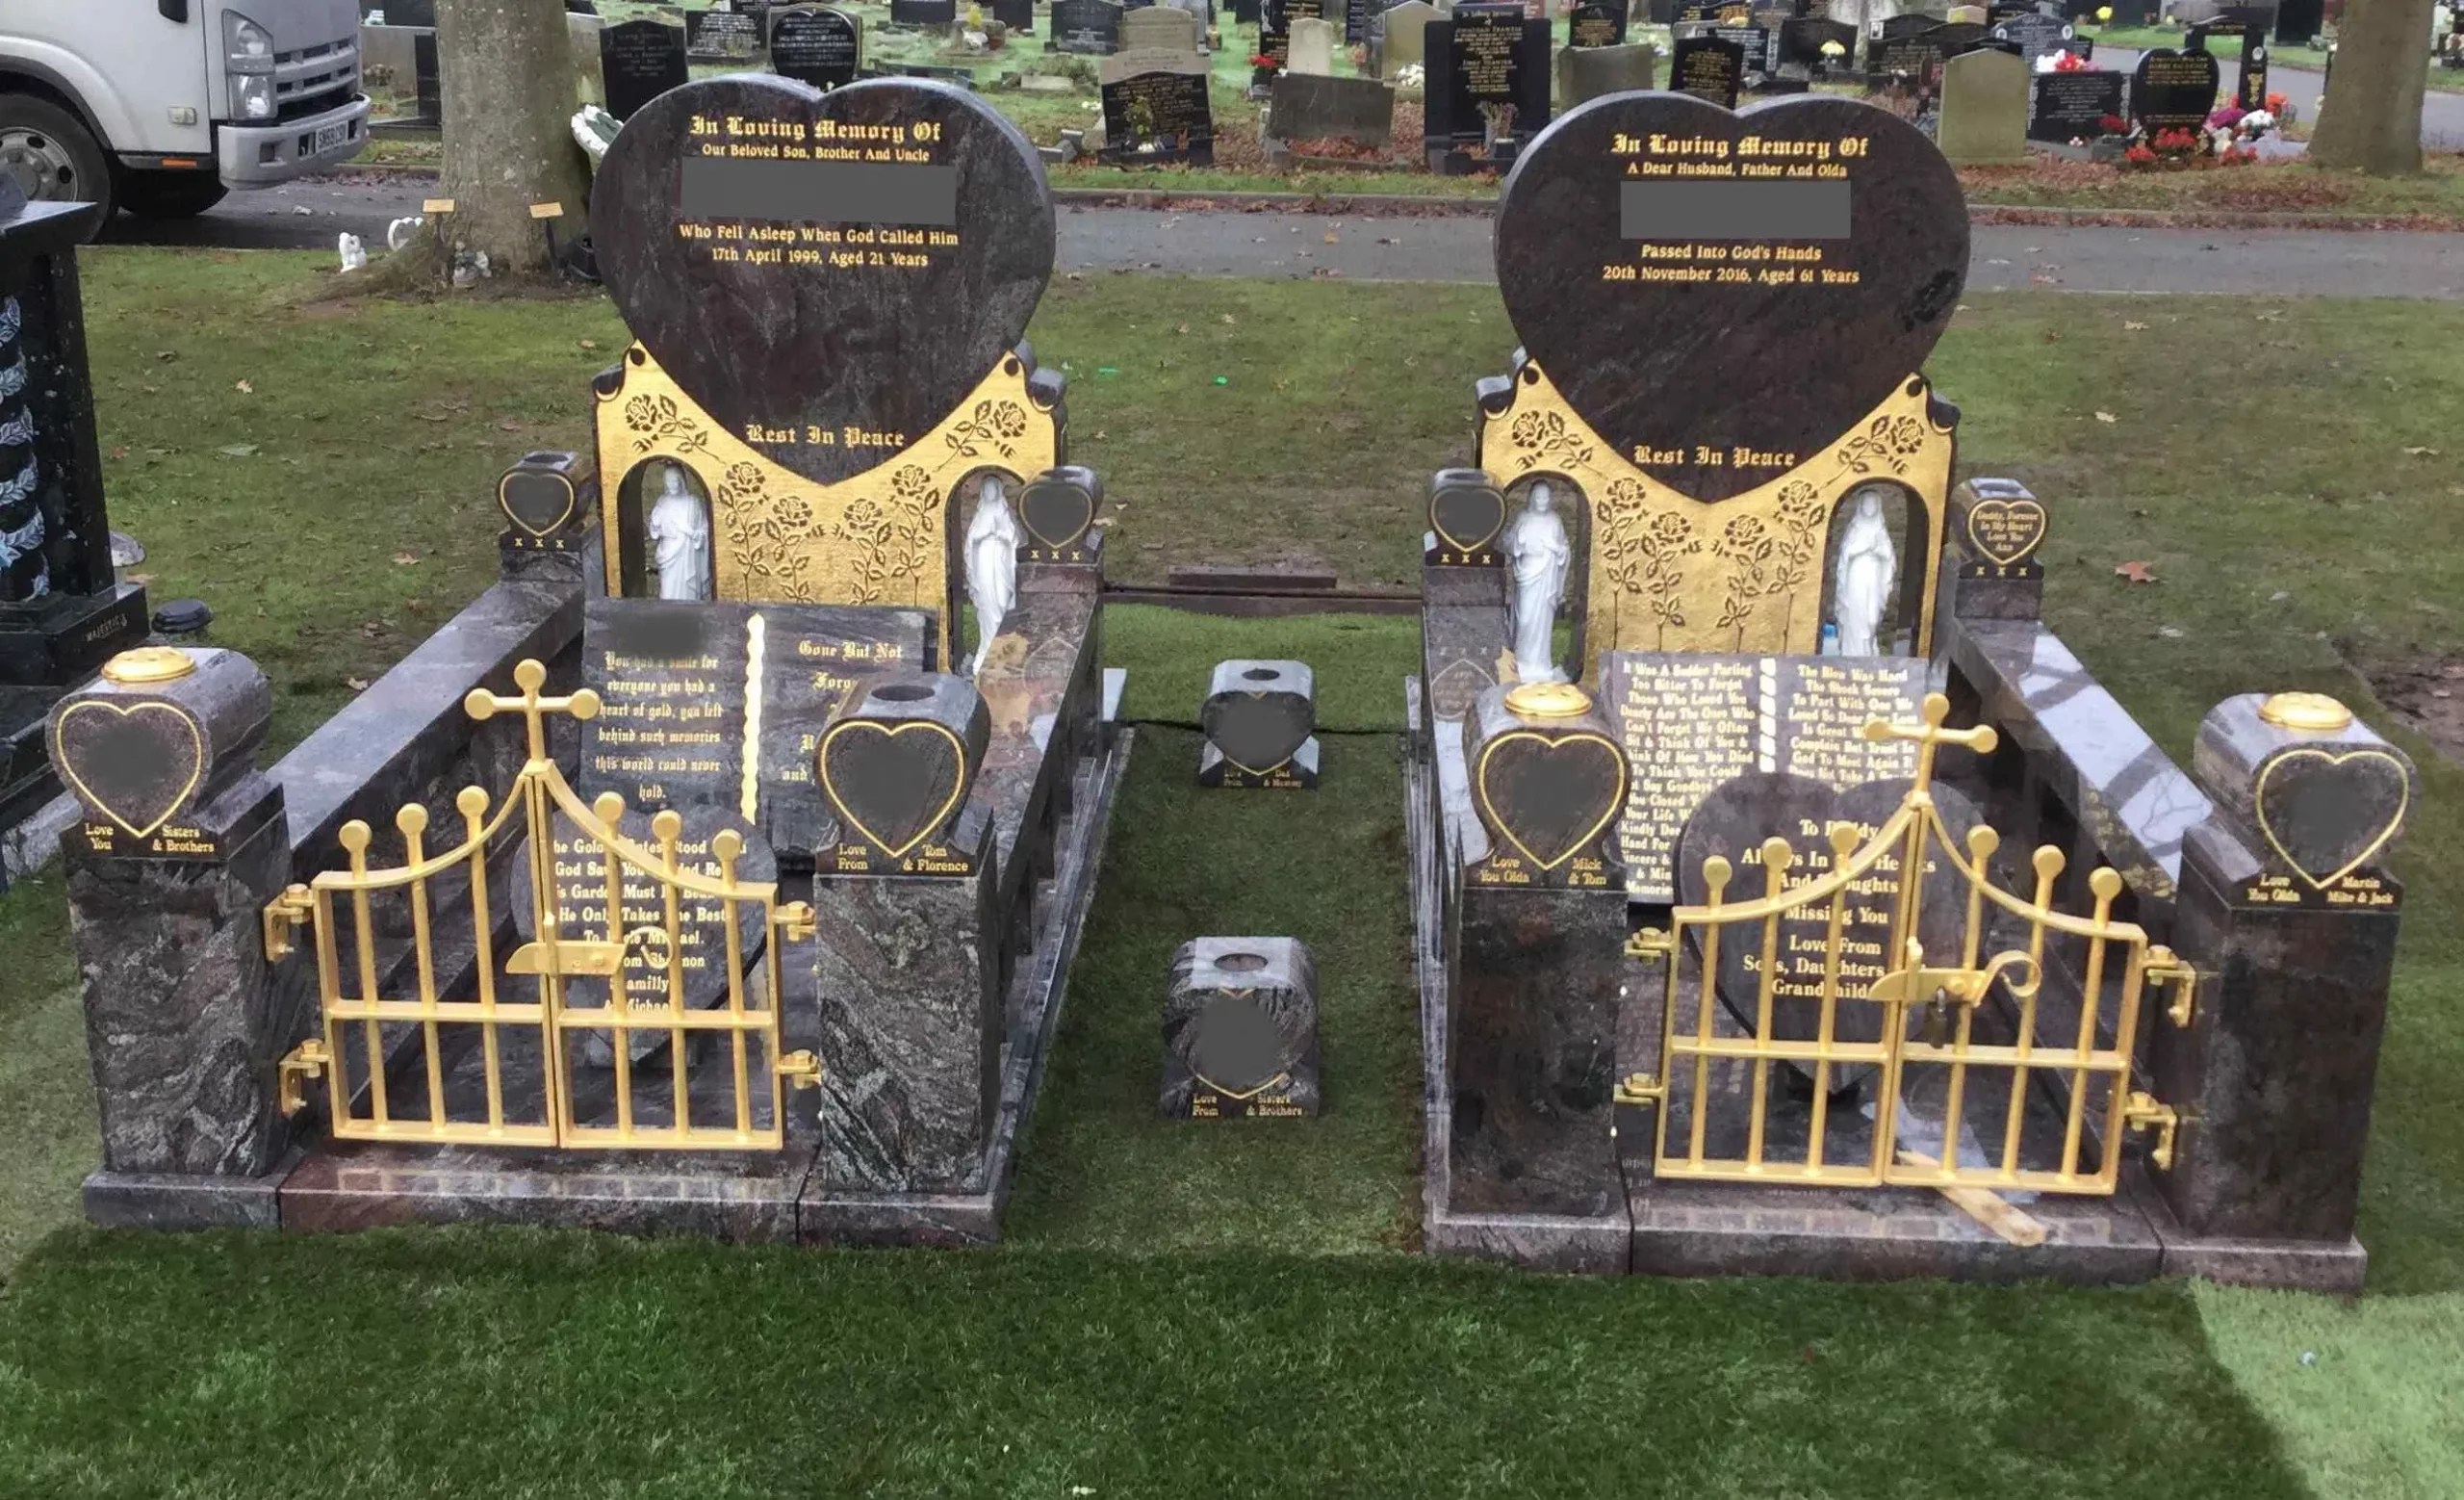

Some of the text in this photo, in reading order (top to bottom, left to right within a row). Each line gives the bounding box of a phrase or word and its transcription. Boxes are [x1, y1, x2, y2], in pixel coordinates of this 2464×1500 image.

[690, 116, 941, 142] In Loving Memory Of
[703, 143, 930, 162] Our Beloved Son, Brother And Uncle
[1611, 134, 1868, 159] In Loving Memory Of
[1628, 162, 1846, 177] A Dear Husband, Father And Olda
[680, 225, 958, 245] Who Fell Asleep When God Called Him
[712, 247, 739, 261] 17th
[745, 248, 781, 263] April
[829, 251, 863, 267] Aged
[870, 252, 885, 264] 21
[891, 253, 928, 266] Years
[1641, 245, 1821, 261] Passed Into God's Hands
[1603, 266, 1635, 279] 20th
[1642, 267, 1711, 281] November
[1758, 270, 1794, 284] Aged
[1801, 271, 1813, 282] 61
[1821, 271, 1860, 283] Years
[746, 424, 904, 449] Rest In Peace
[1634, 445, 1795, 468] Rest In Peace
[799, 640, 902, 662] Gone But Not
[660, 682, 680, 696] you
[633, 702, 645, 716] of
[599, 727, 635, 745] behind
[670, 730, 720, 742] memories
[639, 784, 666, 801] hold.
[86, 823, 114, 836] Love
[163, 824, 200, 838] Sisters
[1800, 819, 1819, 837] To
[90, 838, 112, 849] You
[153, 839, 214, 852] & Brothers
[838, 843, 866, 855] Love
[922, 844, 946, 857] Tom
[837, 858, 868, 869] From
[903, 859, 968, 871] & Florence
[1493, 855, 1520, 867] Love
[1810, 851, 1828, 867] In
[555, 861, 580, 876] God
[624, 885, 654, 899] Must
[559, 908, 727, 922] He Takes Best
[1784, 905, 1888, 925] Missig You
[1839, 938, 1882, 955] From
[1194, 1094, 1217, 1102] Love
